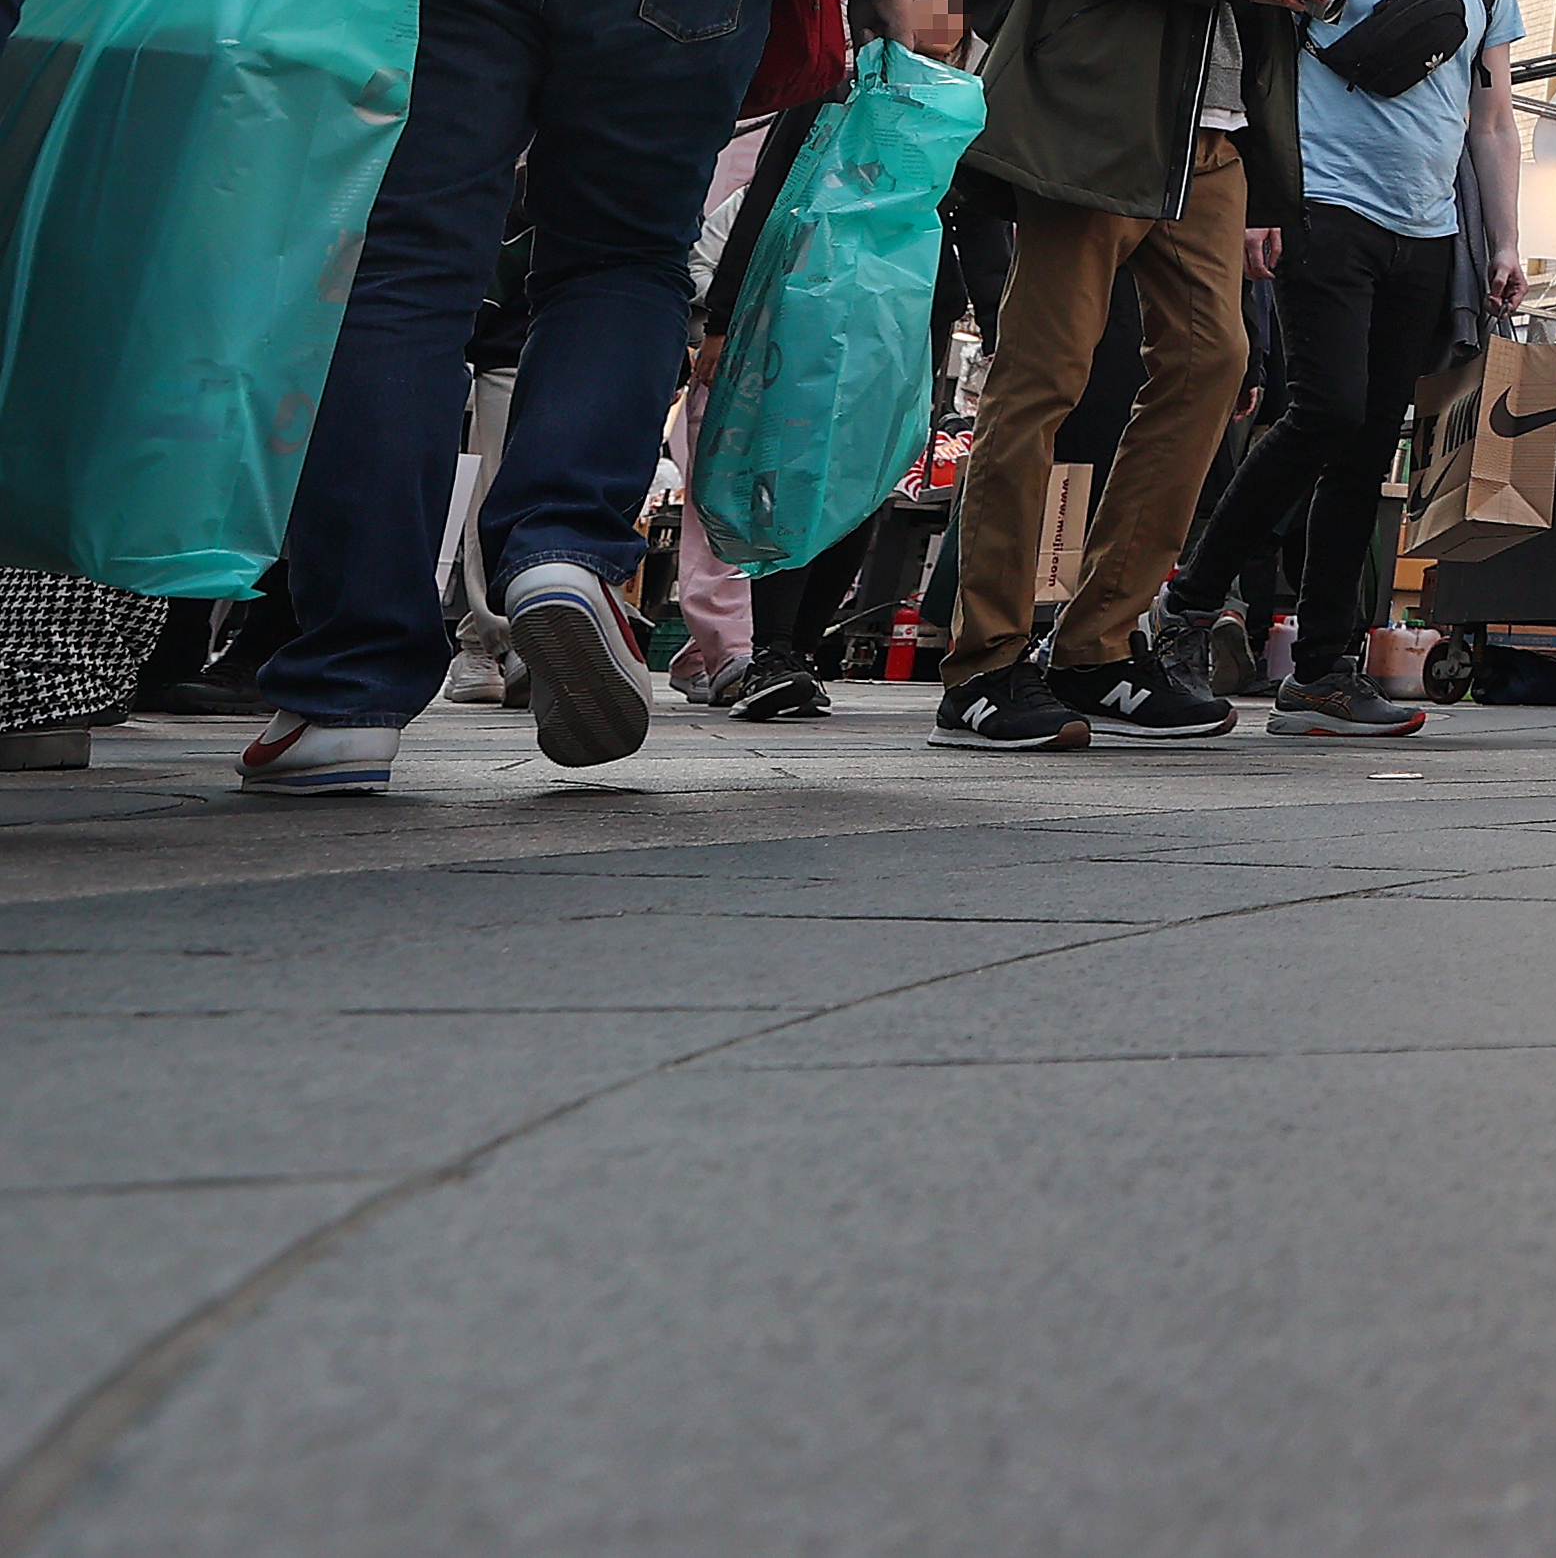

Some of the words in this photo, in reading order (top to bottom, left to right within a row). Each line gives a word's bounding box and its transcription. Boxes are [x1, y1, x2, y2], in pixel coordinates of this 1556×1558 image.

[1048, 478, 1070, 588] www.muji.com
[961, 696, 998, 732] N
[1100, 680, 1152, 715] N
